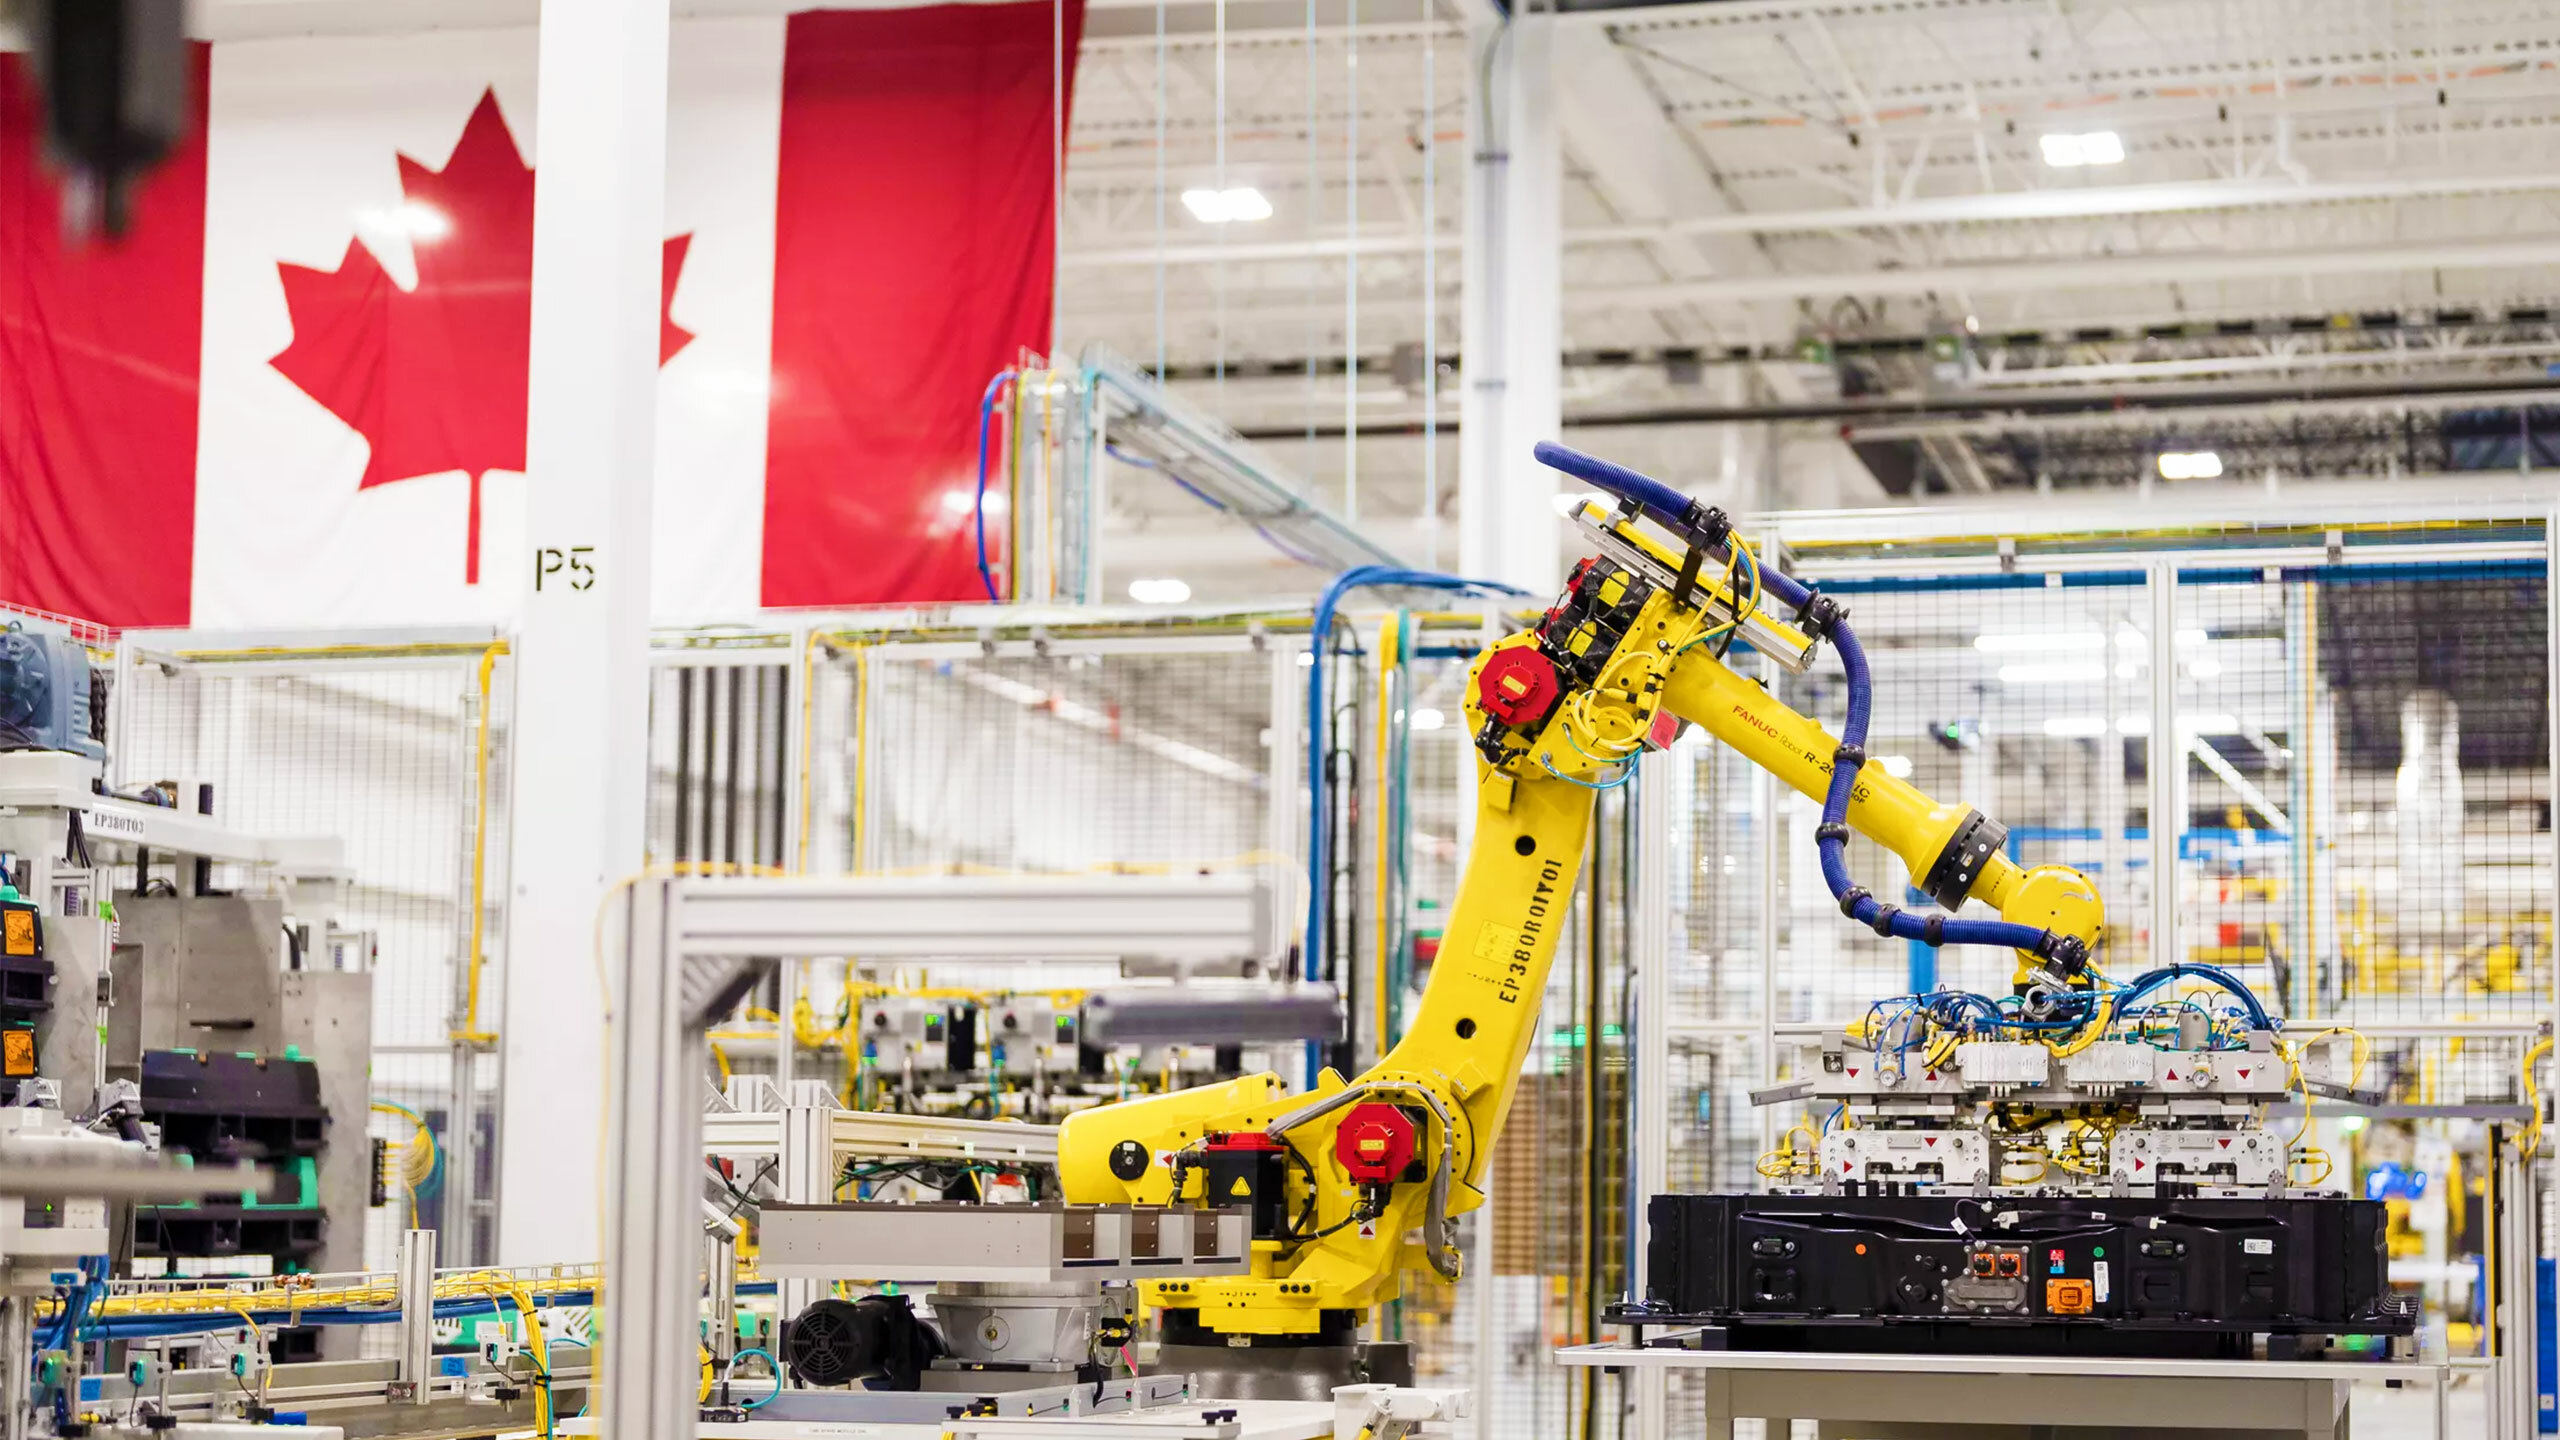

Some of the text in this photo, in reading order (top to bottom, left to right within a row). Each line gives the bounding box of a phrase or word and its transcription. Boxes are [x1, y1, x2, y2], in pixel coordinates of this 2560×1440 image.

[536, 547, 595, 591] P5
[1732, 705, 1778, 738] FANUC
[1499, 858, 1562, 1003] EP380R01Y01
